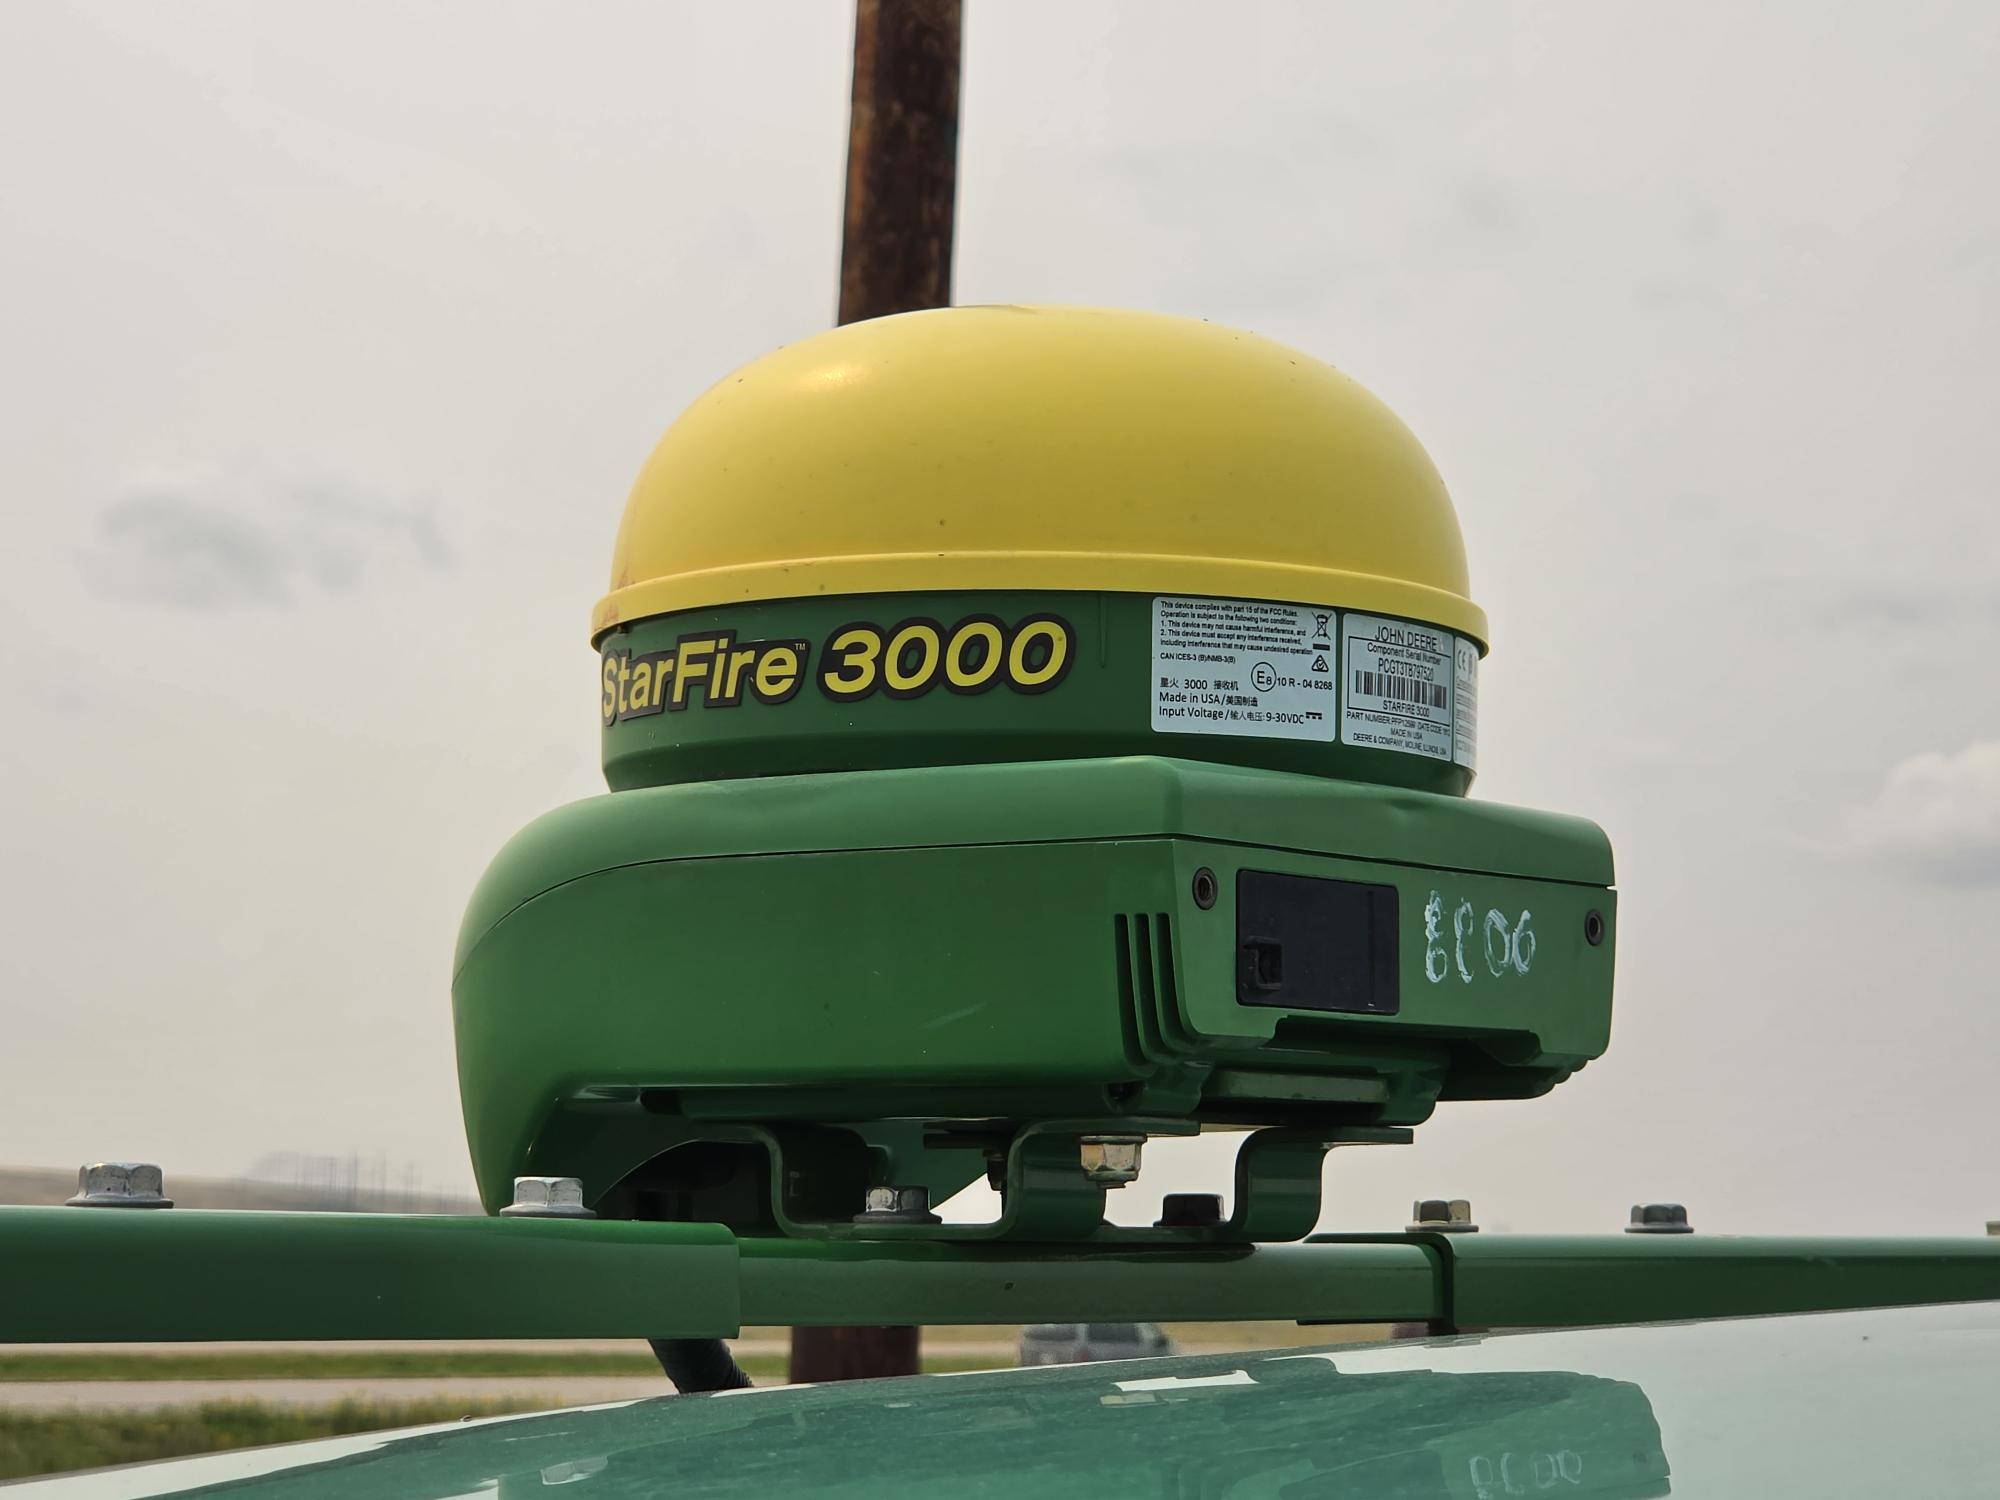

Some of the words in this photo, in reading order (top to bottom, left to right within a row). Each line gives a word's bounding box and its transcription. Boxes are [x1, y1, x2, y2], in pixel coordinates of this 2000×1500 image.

[1161, 610, 1189, 618] Operation
[1235, 615, 1258, 624] following
[1270, 608, 1282, 616] FCC
[1161, 639, 1186, 647] including
[1188, 640, 1221, 648] interference
[1375, 626, 1405, 645] JOHN
[1408, 632, 1437, 651] DEERE
[1367, 642, 1405, 658] Component
[1406, 649, 1421, 661] Serial
[1423, 652, 1442, 665] Number
[602, 638, 798, 718] StarFire
[824, 620, 1067, 695] 3000
[1184, 679, 1208, 690] 3000
[1277, 678, 1287, 686] 10
[1289, 678, 1295, 687] R
[1303, 679, 1312, 688] 04
[1314, 680, 1333, 690] 8268
[1160, 692, 1187, 703] Made
[1190, 693, 1199, 703] in
[1159, 706, 1185, 718] Input
[1383, 700, 1415, 715] STARFIRE
[1417, 705, 1430, 718] 3000
[1347, 711, 1364, 720] PART
[1353, 733, 1373, 743] DEERE
[1391, 728, 1406, 738] MADE
